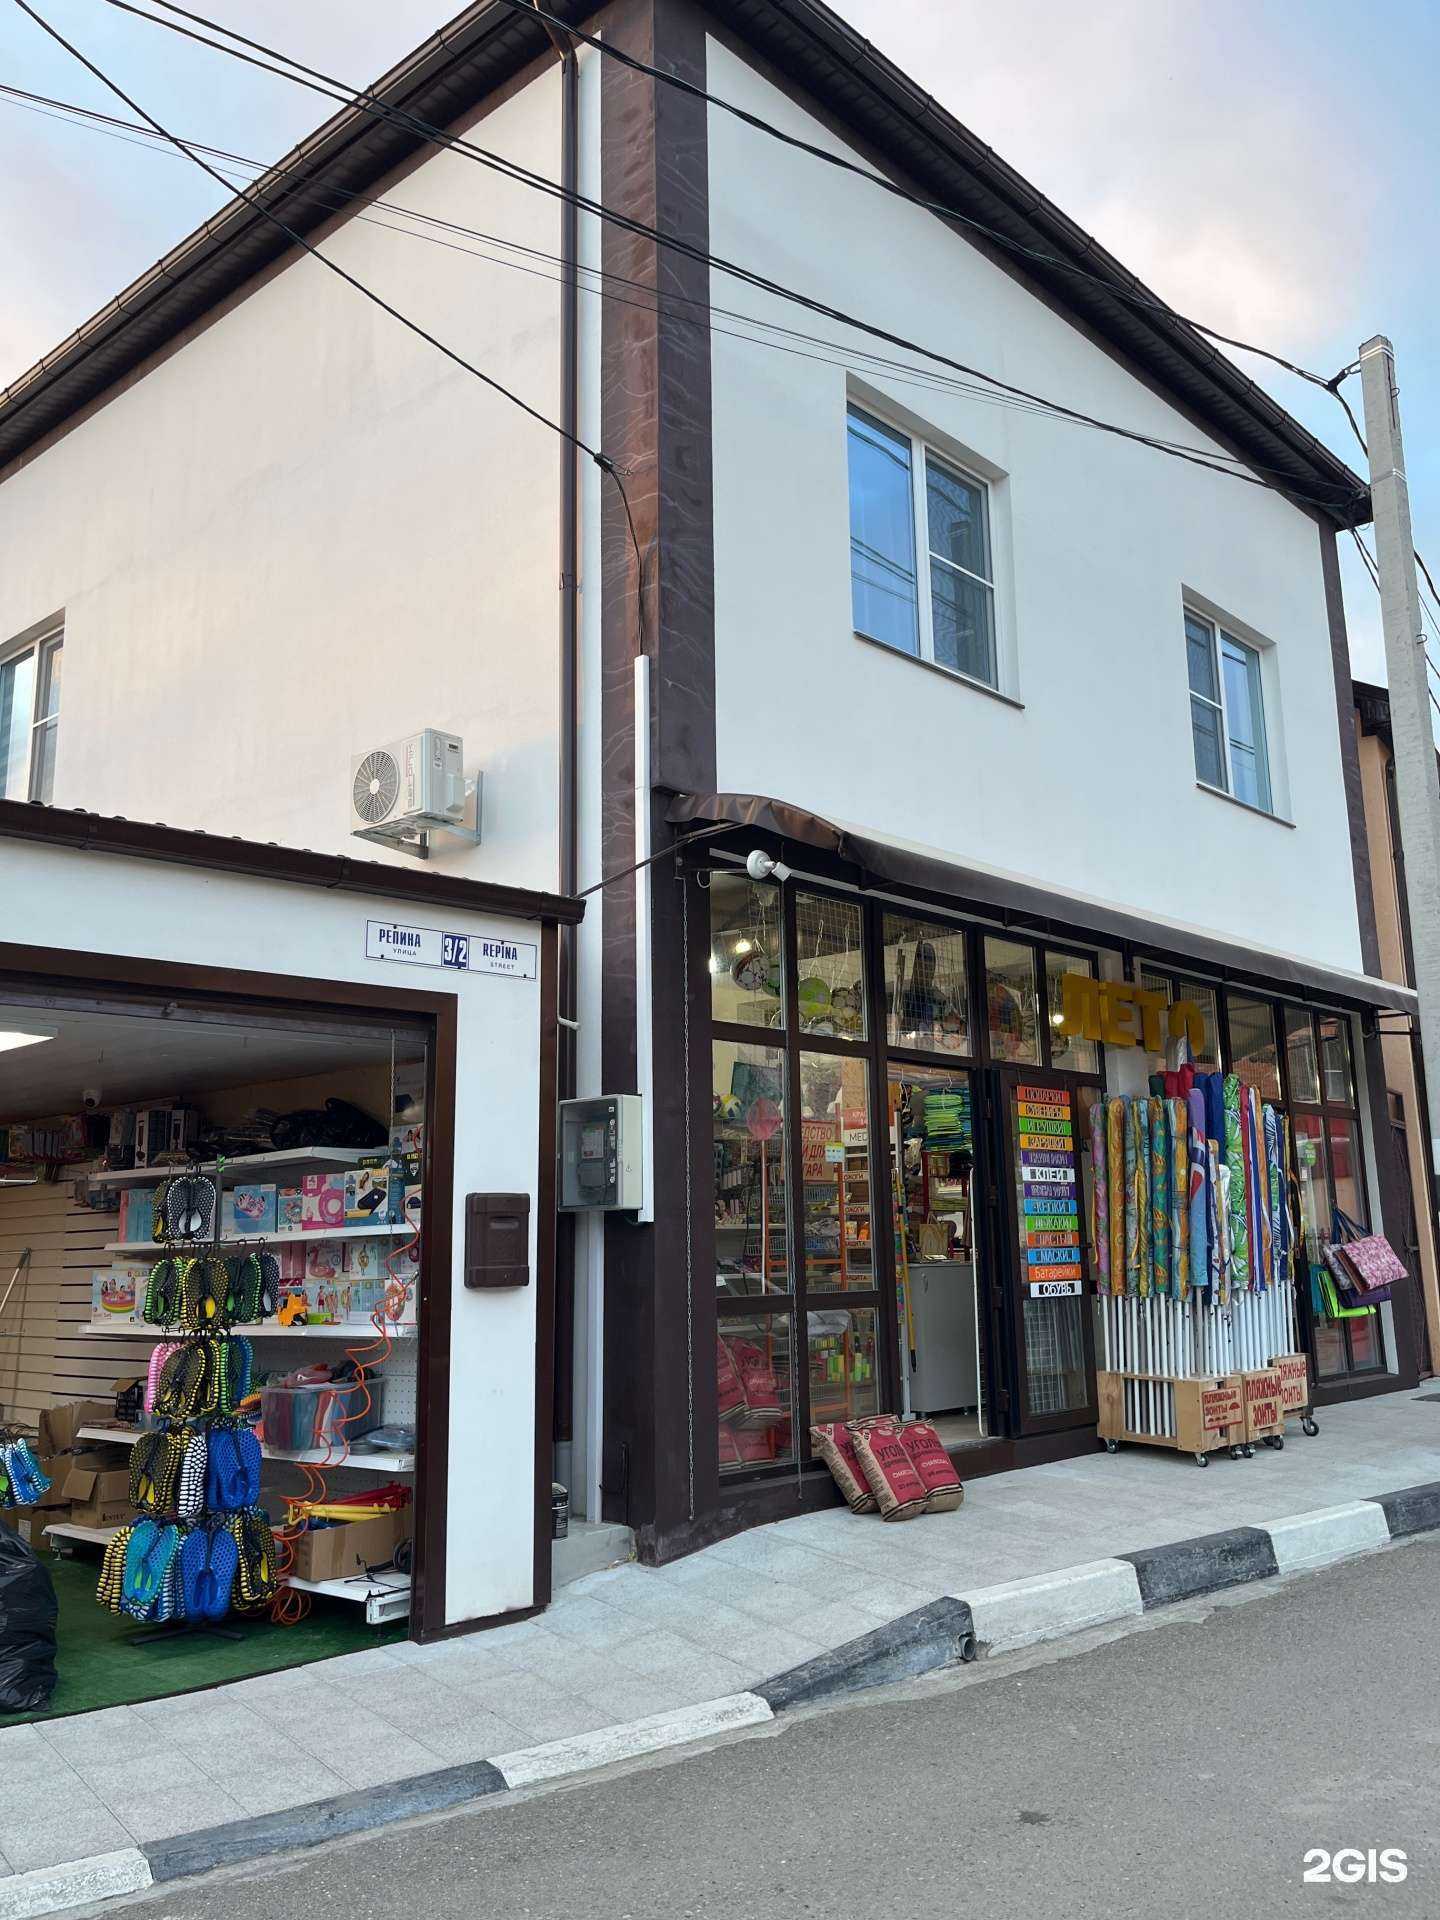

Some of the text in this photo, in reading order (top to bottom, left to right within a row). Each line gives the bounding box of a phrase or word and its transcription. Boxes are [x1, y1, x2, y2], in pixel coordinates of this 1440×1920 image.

[379, 928, 421, 947] РЕПИНА
[443, 937, 467, 963] 3/2
[1026, 1119, 1065, 1134] ИГРУШКИ
[1039, 1249, 1069, 1262] МАСКИ
[1245, 1375, 1281, 1402] ПЛЯЖНЫЕ
